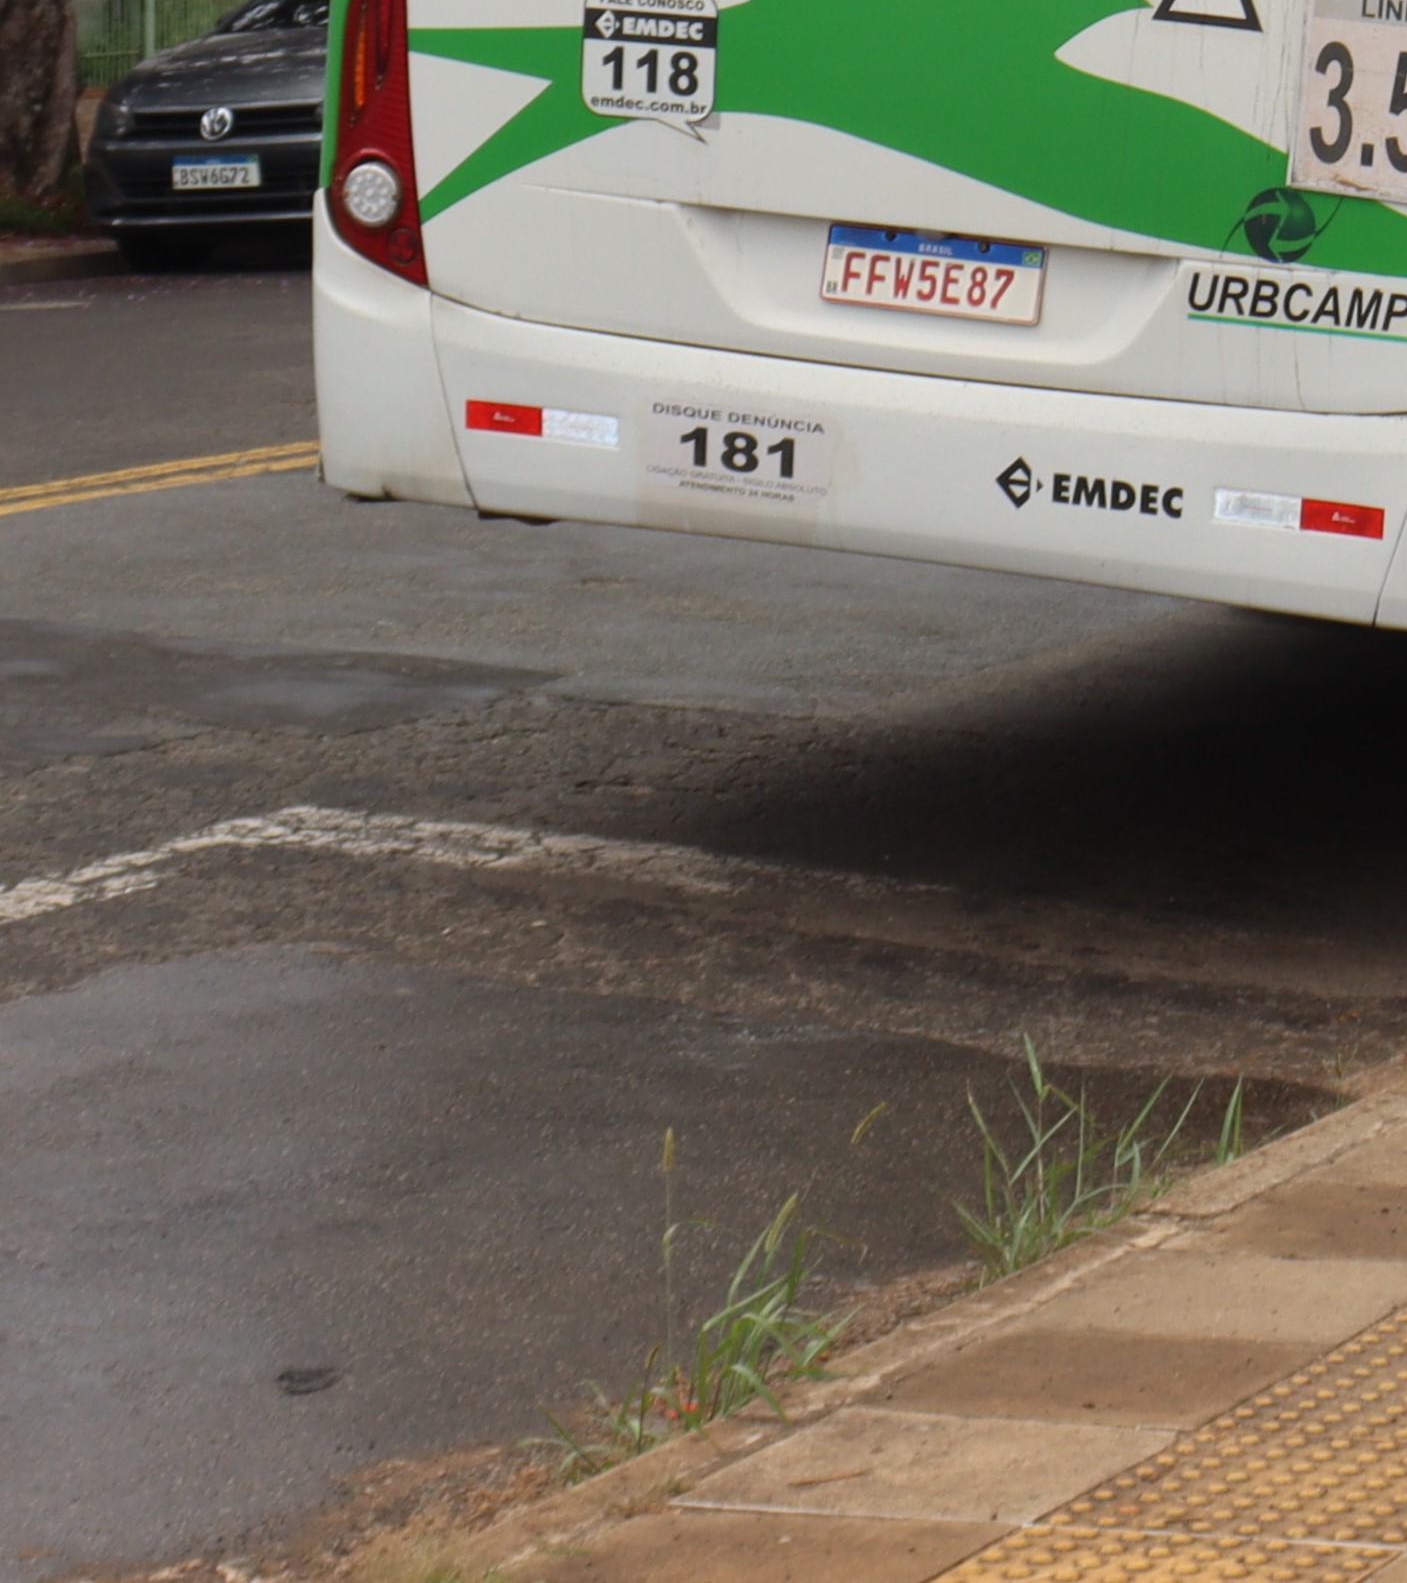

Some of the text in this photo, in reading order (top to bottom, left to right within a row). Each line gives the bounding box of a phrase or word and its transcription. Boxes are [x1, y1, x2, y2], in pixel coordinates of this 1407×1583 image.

[622, 16, 704, 41] EMDEC
[602, 45, 699, 97] 118
[590, 95, 708, 115] emdec.com.br
[918, 243, 953, 255] BRASIL
[841, 251, 1016, 309] FFW5E87
[652, 402, 825, 434] DISQUE DENÚNCIA
[680, 426, 795, 479] 181
[1052, 473, 1184, 519] EMDEC
